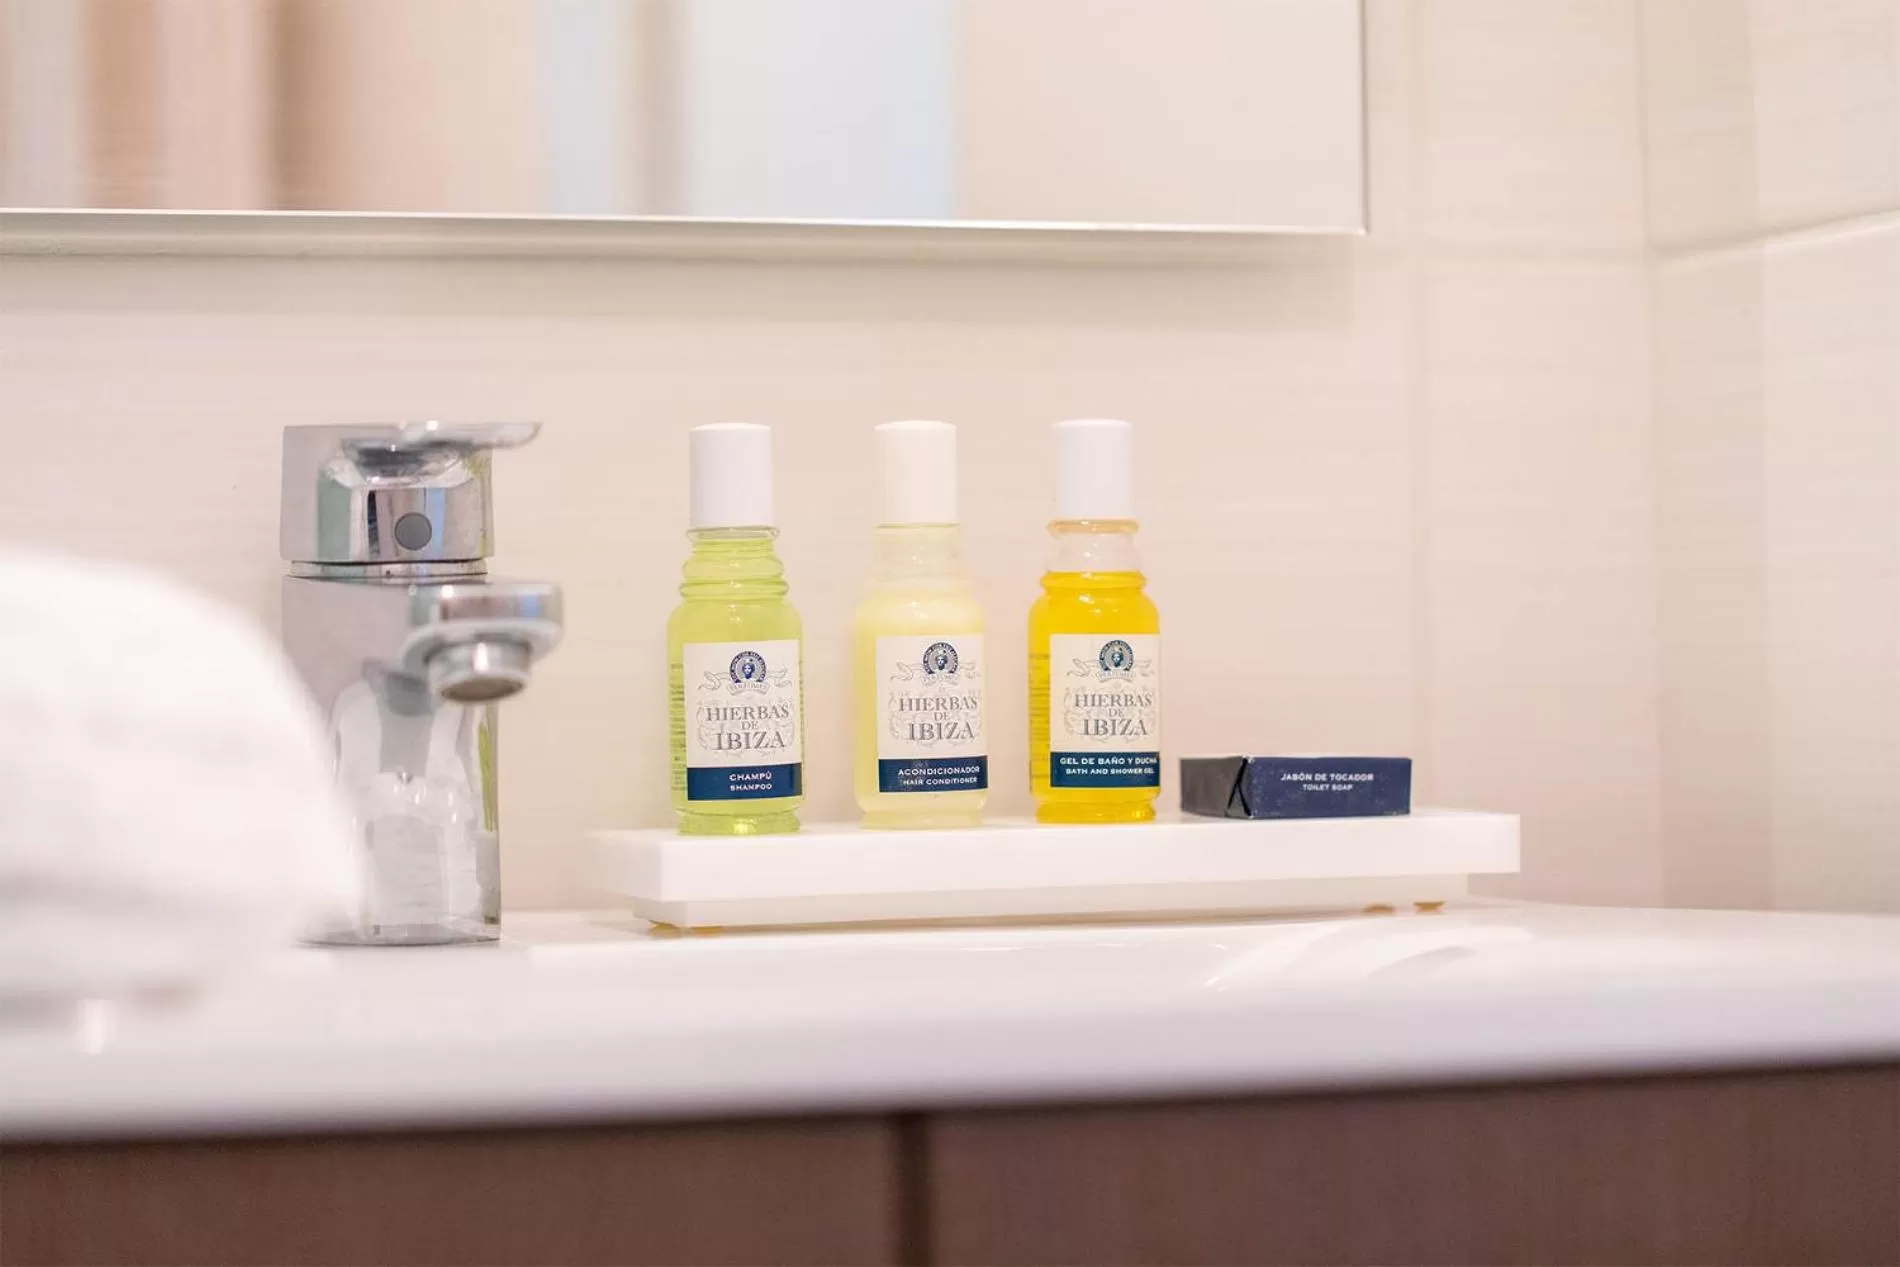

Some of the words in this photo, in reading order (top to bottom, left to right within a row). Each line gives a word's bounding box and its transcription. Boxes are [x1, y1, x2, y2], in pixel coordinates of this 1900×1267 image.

[900, 696, 978, 711] HIERBAS
[1075, 694, 1152, 707] HIERBAS
[705, 704, 790, 721] HIERBAS
[934, 712, 950, 721] DE
[1109, 708, 1124, 717] DE
[741, 721, 760, 731] DE
[908, 722, 975, 740] IBIZA
[1082, 719, 1148, 736] IBIZA
[715, 731, 785, 750] IBIZA
[1060, 757, 1079, 765] GEL
[1081, 757, 1095, 765] DE
[1097, 756, 1125, 765] BAÑO
[1127, 757, 1134, 765] Y
[729, 771, 772, 781] CHAMPÚ
[898, 766, 980, 776] ACONDICIONADOR
[1110, 767, 1142, 775] SHOWER
[1281, 772, 1312, 781] JABÓN
[1314, 773, 1327, 781] DE
[1329, 773, 1374, 781] TOCADOR
[730, 783, 772, 791] SHAMPOO
[1303, 783, 1330, 791] TOILET
[1331, 783, 1354, 791] SOAP
